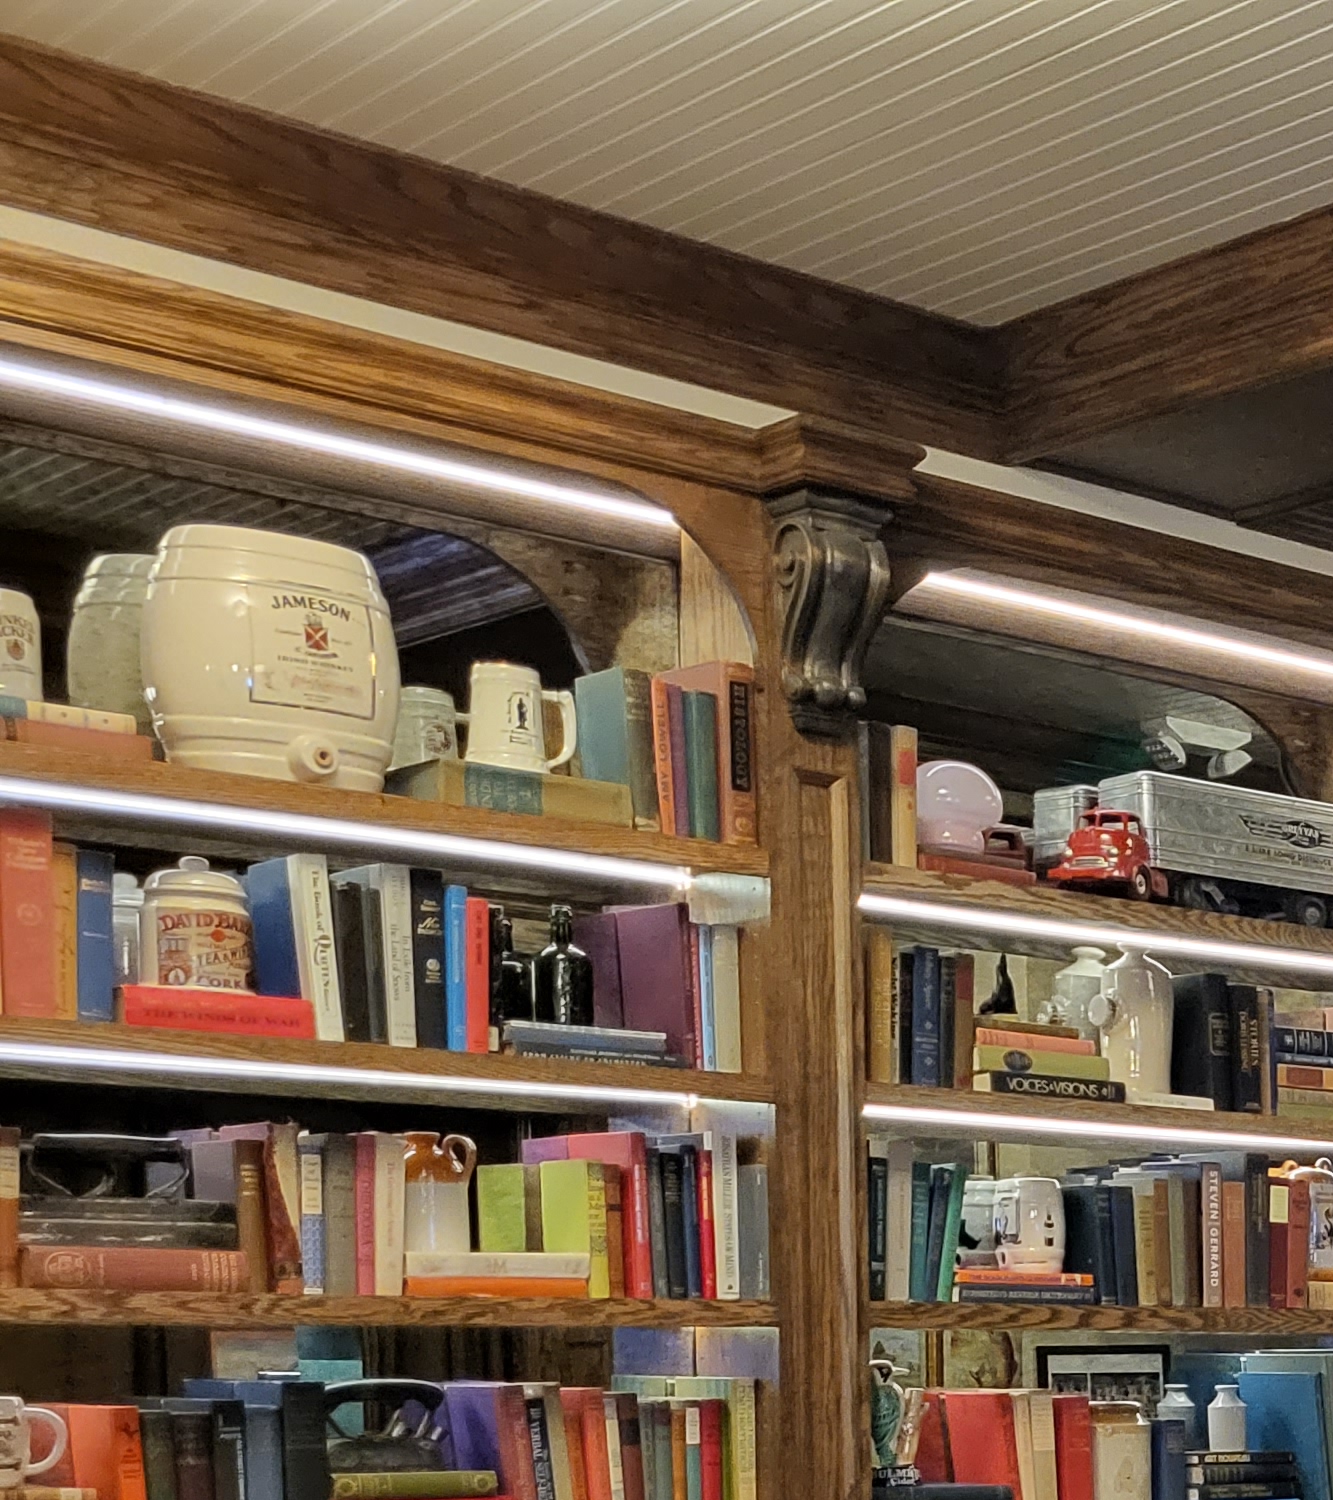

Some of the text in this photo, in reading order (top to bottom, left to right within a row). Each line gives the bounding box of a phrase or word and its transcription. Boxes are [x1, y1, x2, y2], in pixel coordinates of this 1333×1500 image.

[271, 595, 351, 622] JAMESON
[656, 701, 670, 803] AMY LOWELL
[732, 683, 750, 790] HISTOLOGY
[158, 913, 214, 932] DAVID
[1007, 1075, 1049, 1094] VOICES
[1054, 1080, 1099, 1099] VISIONS
[722, 1178, 734, 1210] MILLER
[1208, 1170, 1219, 1288] STEVEN GERRARD
[529, 1420, 544, 1461] VERBAL
